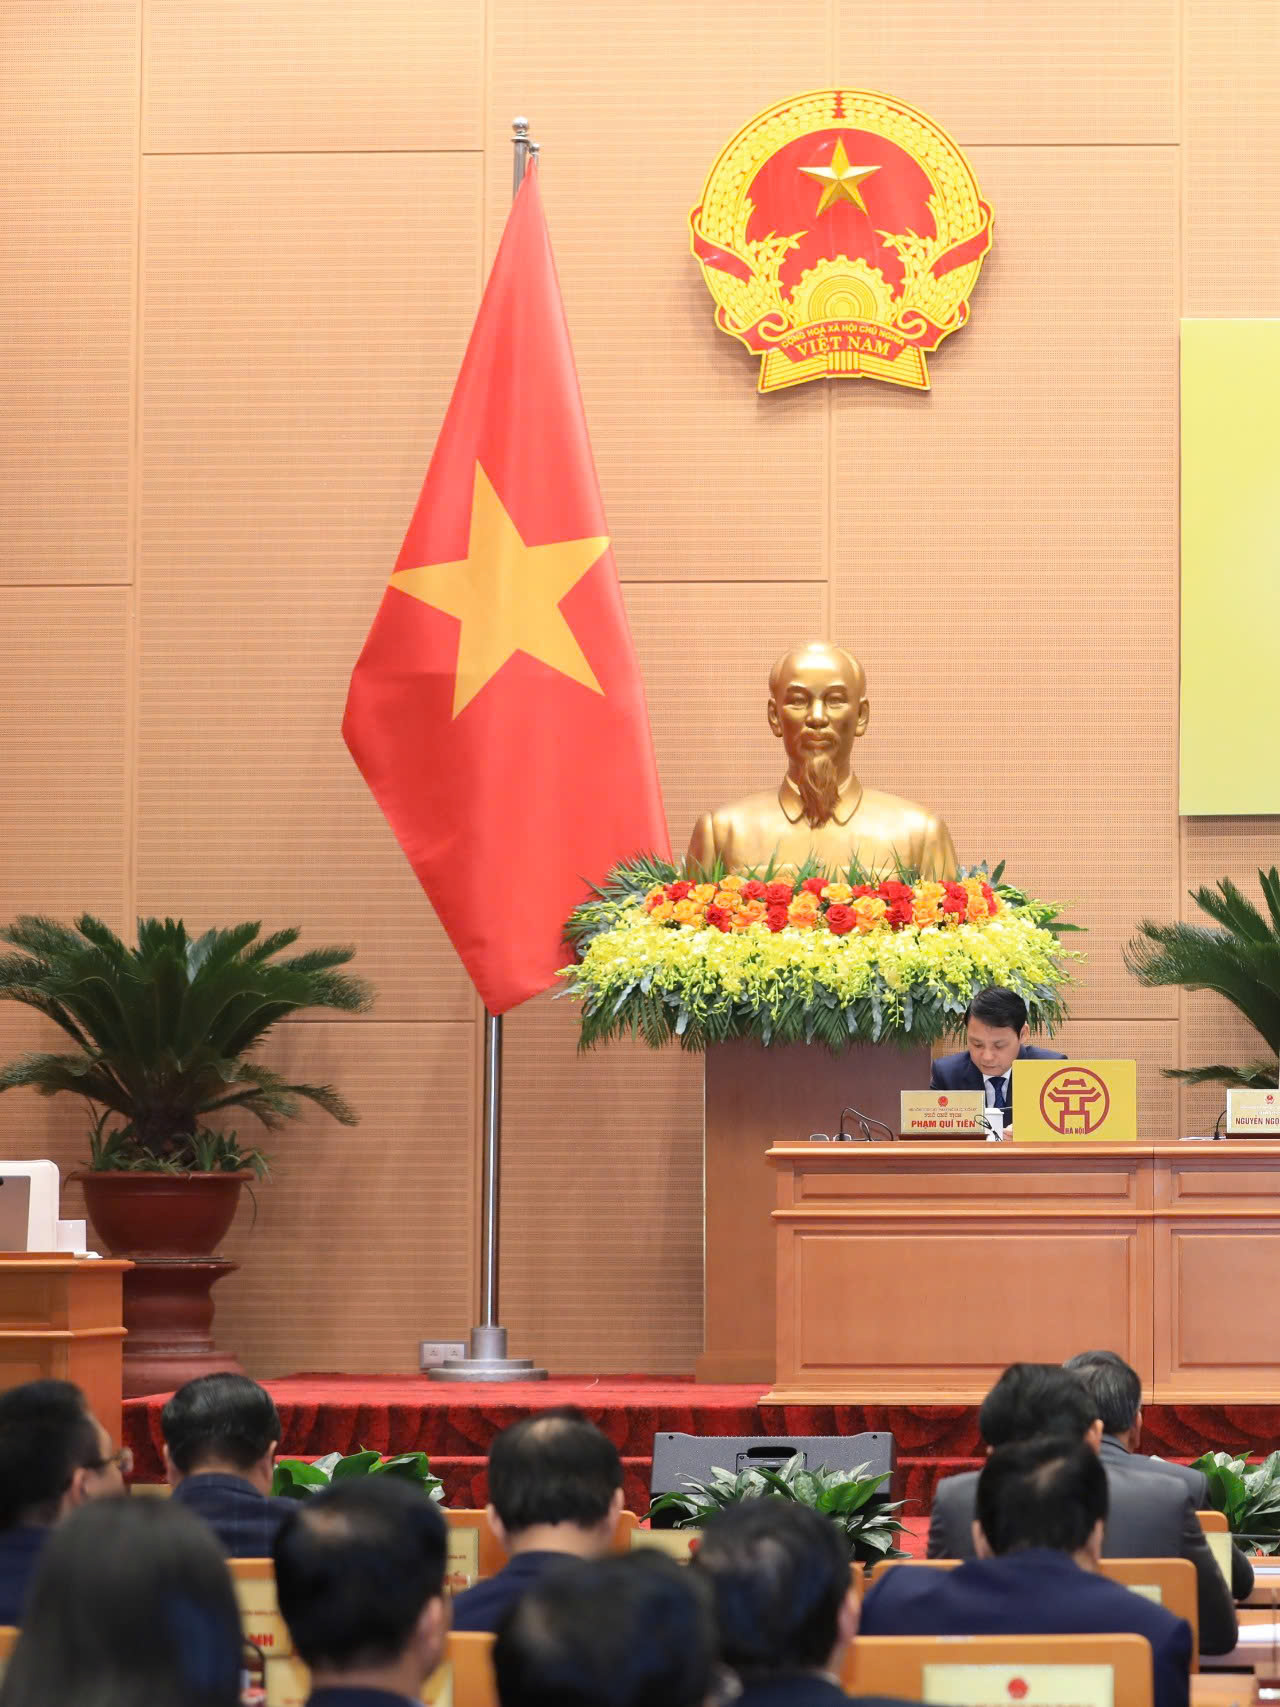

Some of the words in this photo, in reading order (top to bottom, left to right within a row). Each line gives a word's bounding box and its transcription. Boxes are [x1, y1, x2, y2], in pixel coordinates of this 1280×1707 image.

[795, 334, 842, 356] VIỆT
[848, 335, 891, 356] NAM
[911, 1120, 937, 1129] PHẠM
